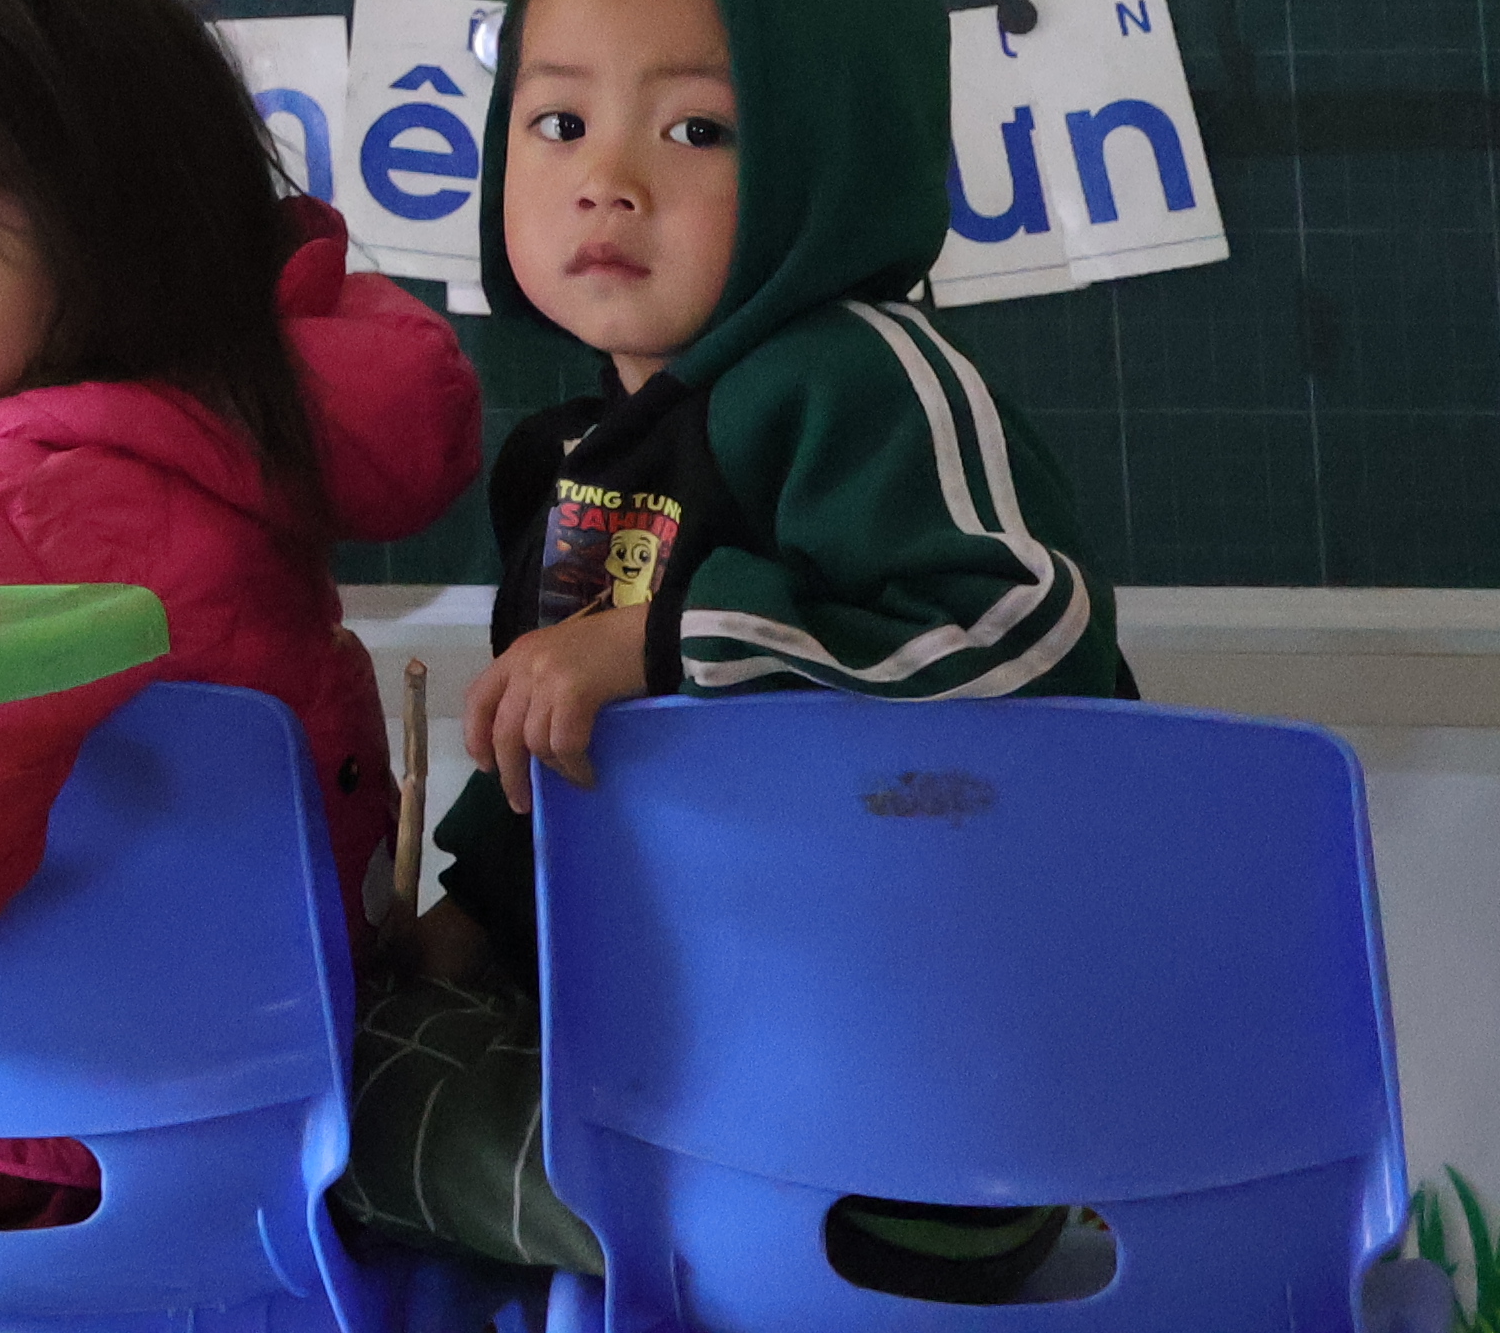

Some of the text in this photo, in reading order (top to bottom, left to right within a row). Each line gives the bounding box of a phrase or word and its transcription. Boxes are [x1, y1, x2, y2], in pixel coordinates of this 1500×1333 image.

[1116, 0, 1151, 36] N
[360, 64, 479, 221] ê
[1065, 99, 1196, 225] n
[557, 479, 622, 510] TUNG
